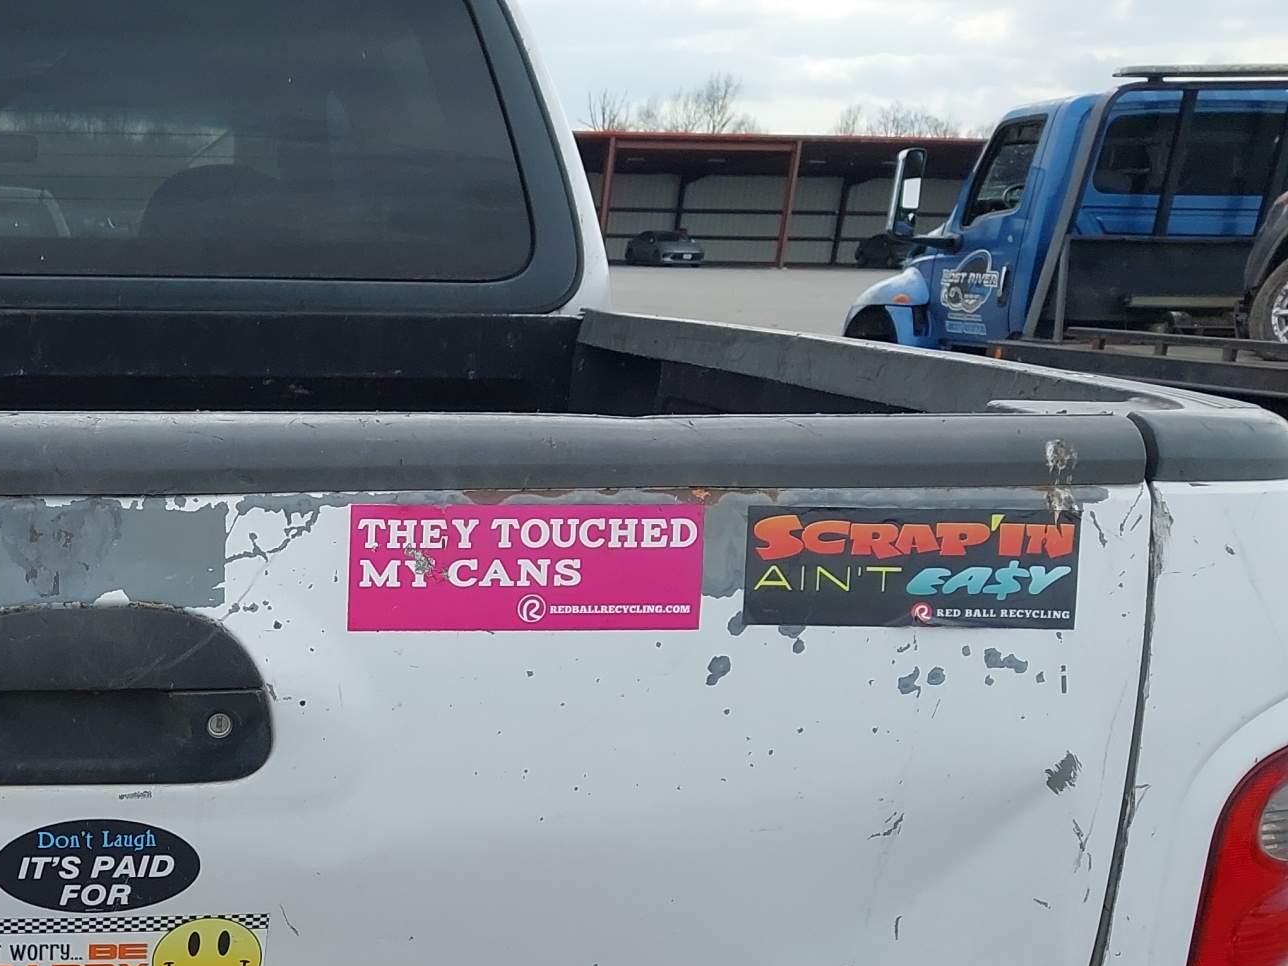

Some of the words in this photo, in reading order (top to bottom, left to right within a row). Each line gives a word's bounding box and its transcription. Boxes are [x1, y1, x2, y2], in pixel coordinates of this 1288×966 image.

[357, 518, 480, 549] THEY
[490, 518, 698, 548] TOUCHED
[753, 513, 1076, 560] SCRAP'IN
[359, 559, 436, 588] MY
[447, 558, 582, 587] CANS
[753, 564, 903, 593] AIN'T
[549, 604, 690, 614] REDBALLRECYCLING.COM
[936, 608, 962, 618] RED
[965, 608, 997, 619] BALL
[1000, 608, 1070, 620] RECYCLING
[37, 831, 93, 850] Don't
[102, 829, 157, 852] Laugh
[18, 855, 81, 880] IT'S
[91, 854, 175, 879] PAID
[59, 884, 131, 906] FOR
[89, 943, 149, 961] BE
